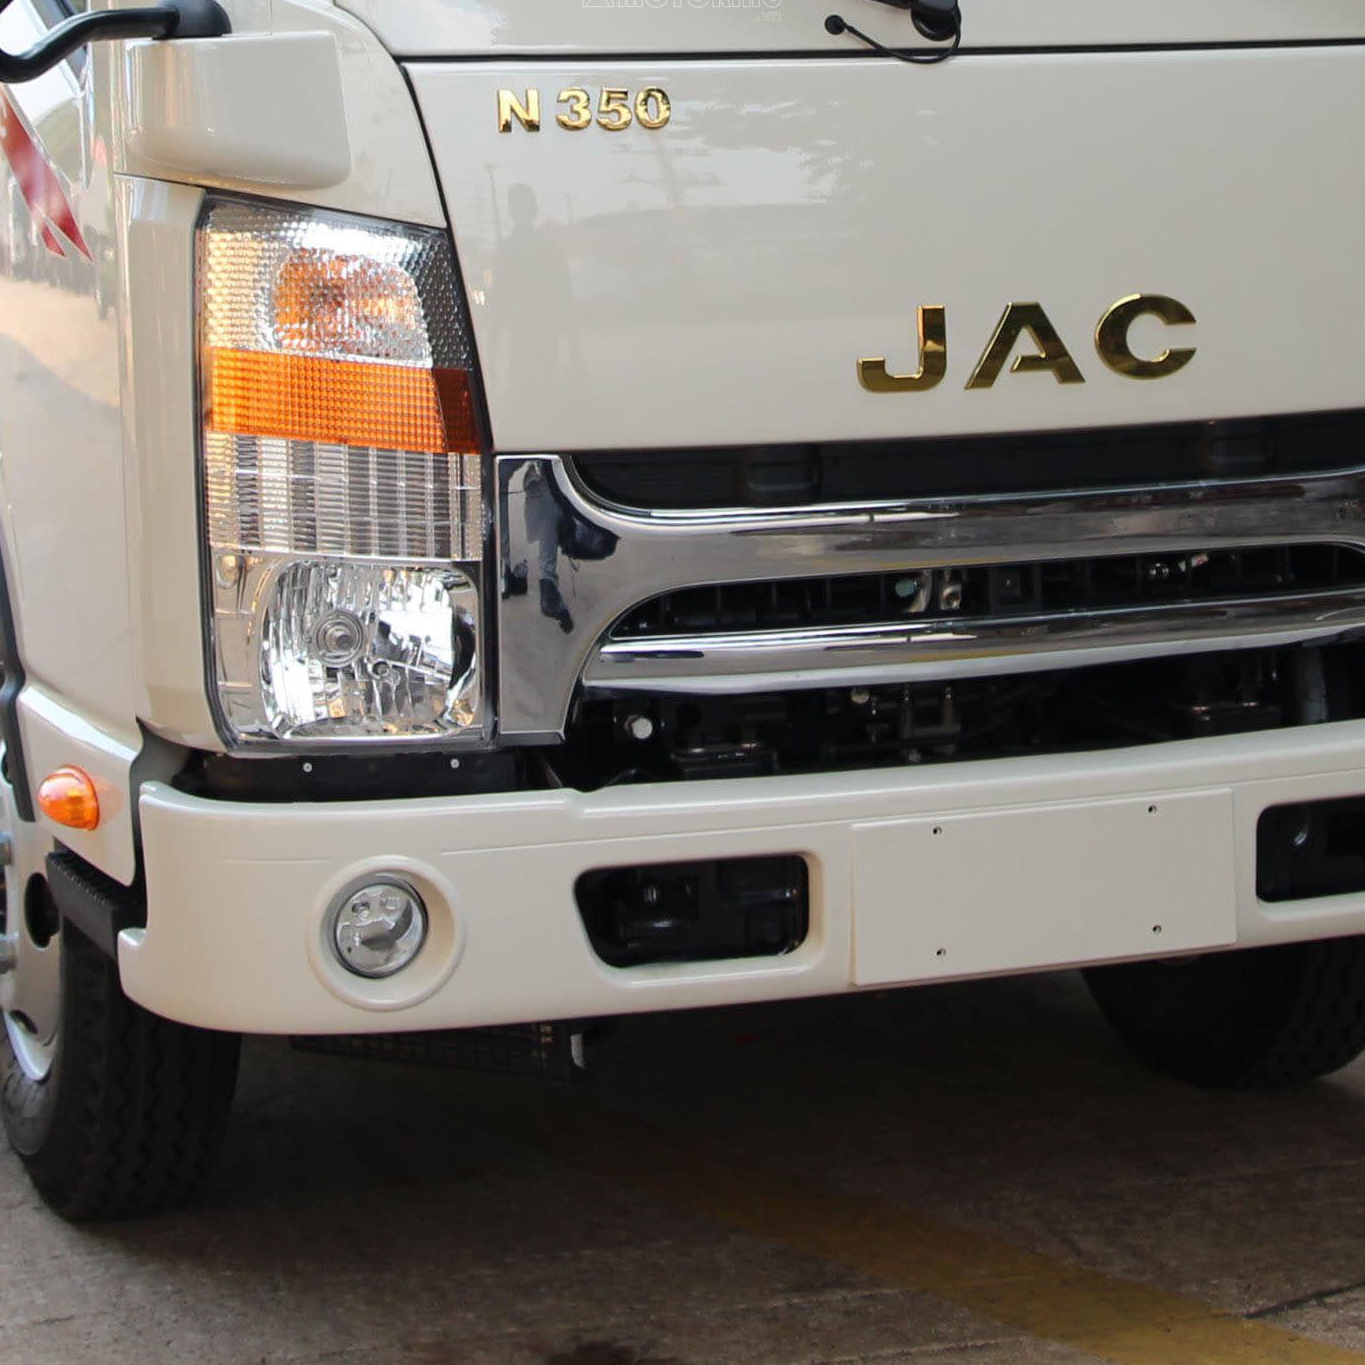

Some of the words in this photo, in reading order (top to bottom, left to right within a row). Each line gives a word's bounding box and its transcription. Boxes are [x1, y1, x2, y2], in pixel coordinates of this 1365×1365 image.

[497, 88, 541, 133] N
[555, 86, 671, 131] 350
[856, 293, 1197, 393] JAC
